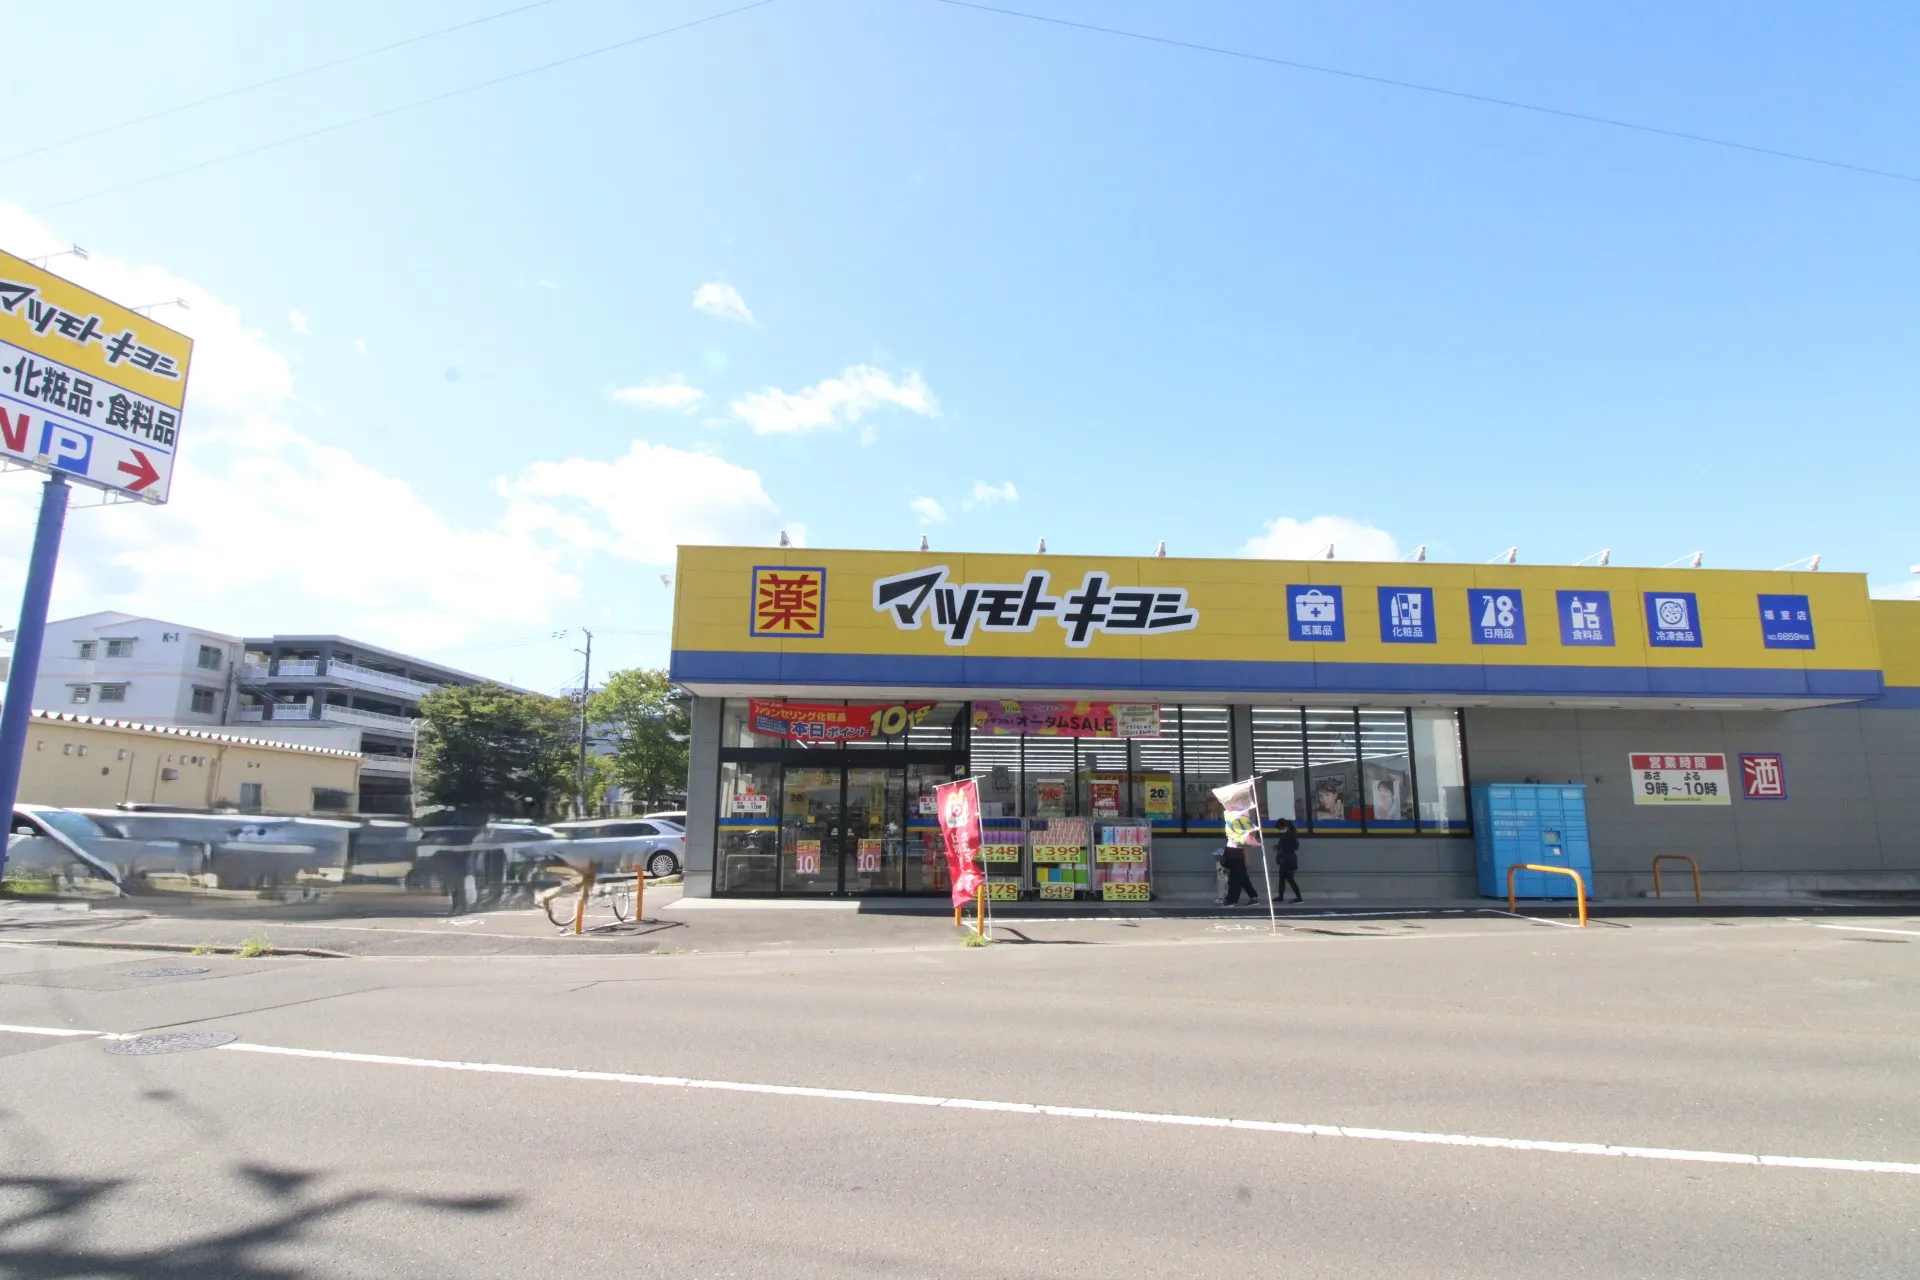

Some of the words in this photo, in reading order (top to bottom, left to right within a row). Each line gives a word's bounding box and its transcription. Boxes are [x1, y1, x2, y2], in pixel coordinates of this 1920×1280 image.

[49, 424, 88, 468] P
[758, 573, 817, 630] 薬
[878, 569, 1194, 643] マツモトキヨシ
[1301, 625, 1333, 636] 医薬品
[1392, 627, 1423, 638] 化粧品
[1484, 628, 1514, 639] 日用品
[1572, 630, 1603, 641] 食料品
[163, 632, 179, 642] K-1
[1656, 631, 1695, 642] 冷凍食品
[791, 721, 825, 739] 本日
[1649, 756, 1707, 769] 営業時間
[1643, 771, 1661, 781] あさ
[1683, 771, 1701, 781] よる
[1743, 757, 1782, 795] 酒
